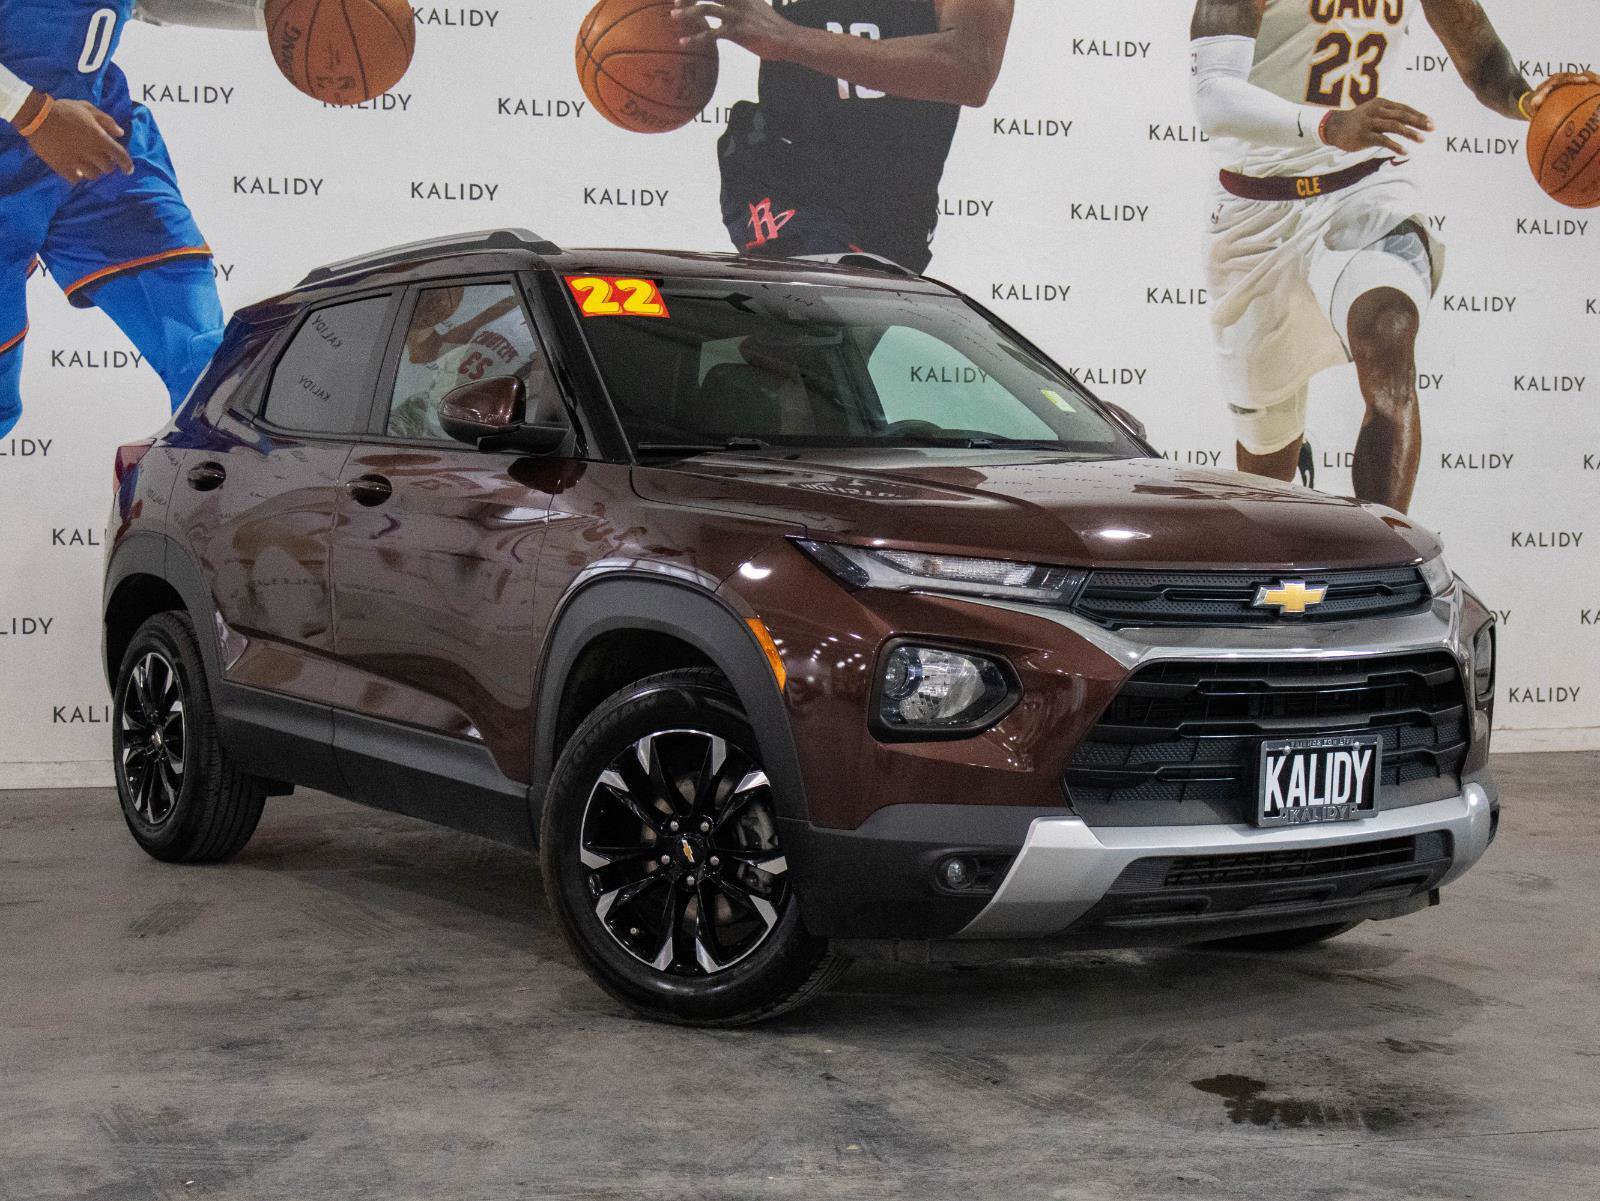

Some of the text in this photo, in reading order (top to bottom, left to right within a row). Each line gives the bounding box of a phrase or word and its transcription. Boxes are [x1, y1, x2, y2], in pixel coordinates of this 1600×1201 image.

[413, 7, 499, 27] KALIDY
[78, 9, 116, 73] 0
[1073, 39, 1151, 57] KALIDY
[1305, 30, 1387, 107] 23
[1406, 56, 1448, 72] IDY
[143, 84, 234, 104] KALIDY
[499, 98, 585, 118] KALIDY
[994, 118, 1072, 136] KALIDY
[1149, 124, 1210, 142] KALI
[1447, 137, 1518, 154] KALIDY
[234, 176, 323, 195] KALIDY
[412, 182, 498, 200] KALIDY
[1296, 176, 1321, 197] CLE
[585, 188, 668, 206] KALIDY
[936, 199, 993, 216] LIDY
[1071, 203, 1149, 221] KALIDY
[1517, 218, 1588, 236] KALIDY
[571, 277, 664, 315] 22
[992, 284, 1070, 302] KALIDY
[1147, 287, 1206, 304] KALID
[1443, 295, 1516, 312] KALIDY
[52, 350, 142, 368] KALIDY
[911, 366, 988, 383] KALIDY
[1070, 368, 1147, 385] KALIDY
[1514, 376, 1585, 391] KALIDY
[0, 440, 52, 456] IDY
[1324, 452, 1354, 467] LID
[1441, 453, 1513, 469] KALIDY
[53, 528, 107, 545] KAL
[1512, 531, 1582, 547] KALIDY
[0, 618, 53, 634] IDY
[1509, 686, 1580, 702] KALIDY
[53, 706, 109, 723] KALI
[1264, 749, 1372, 812] KALIDY
[1288, 805, 1350, 824] KALIDY
